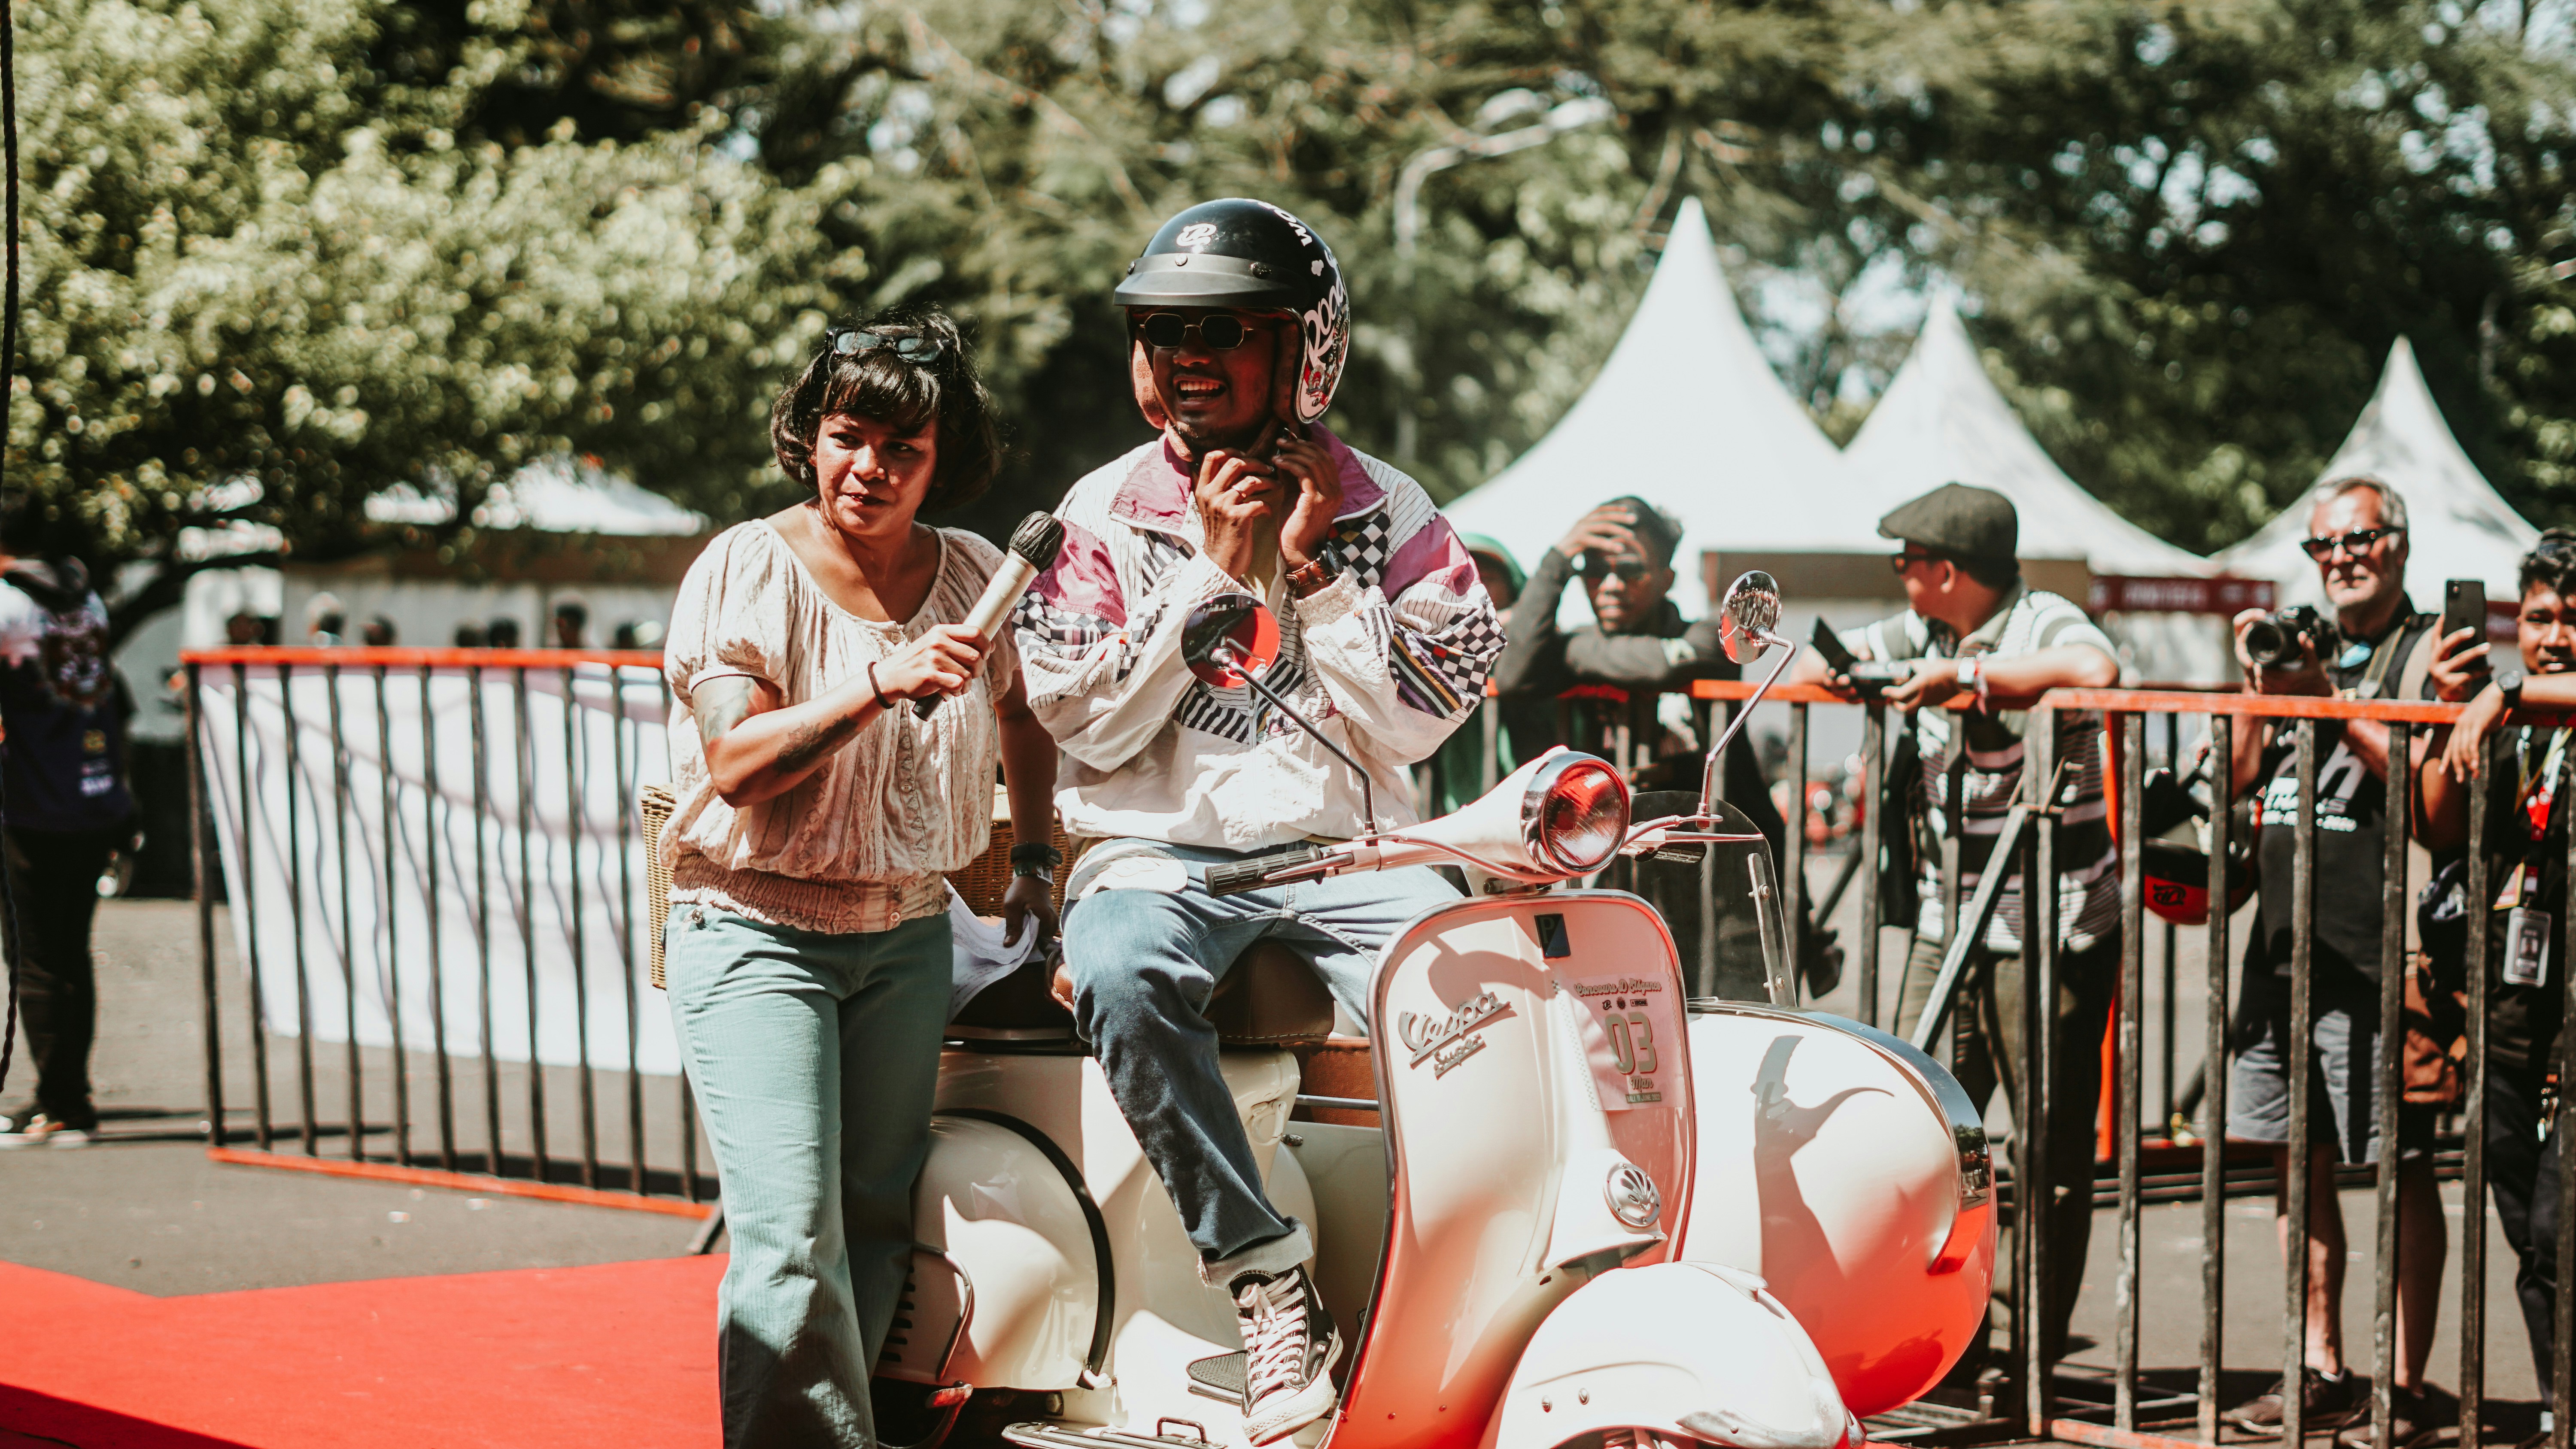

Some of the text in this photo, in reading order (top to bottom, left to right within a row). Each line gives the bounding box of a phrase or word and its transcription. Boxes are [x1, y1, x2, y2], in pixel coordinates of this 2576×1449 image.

[1539, 916, 1555, 944] P
[1574, 983, 1619, 997] Concours
[1398, 991, 1511, 1069] Vespa
[1605, 1011, 1658, 1075] 03
[1629, 1075, 1654, 1093] Man
